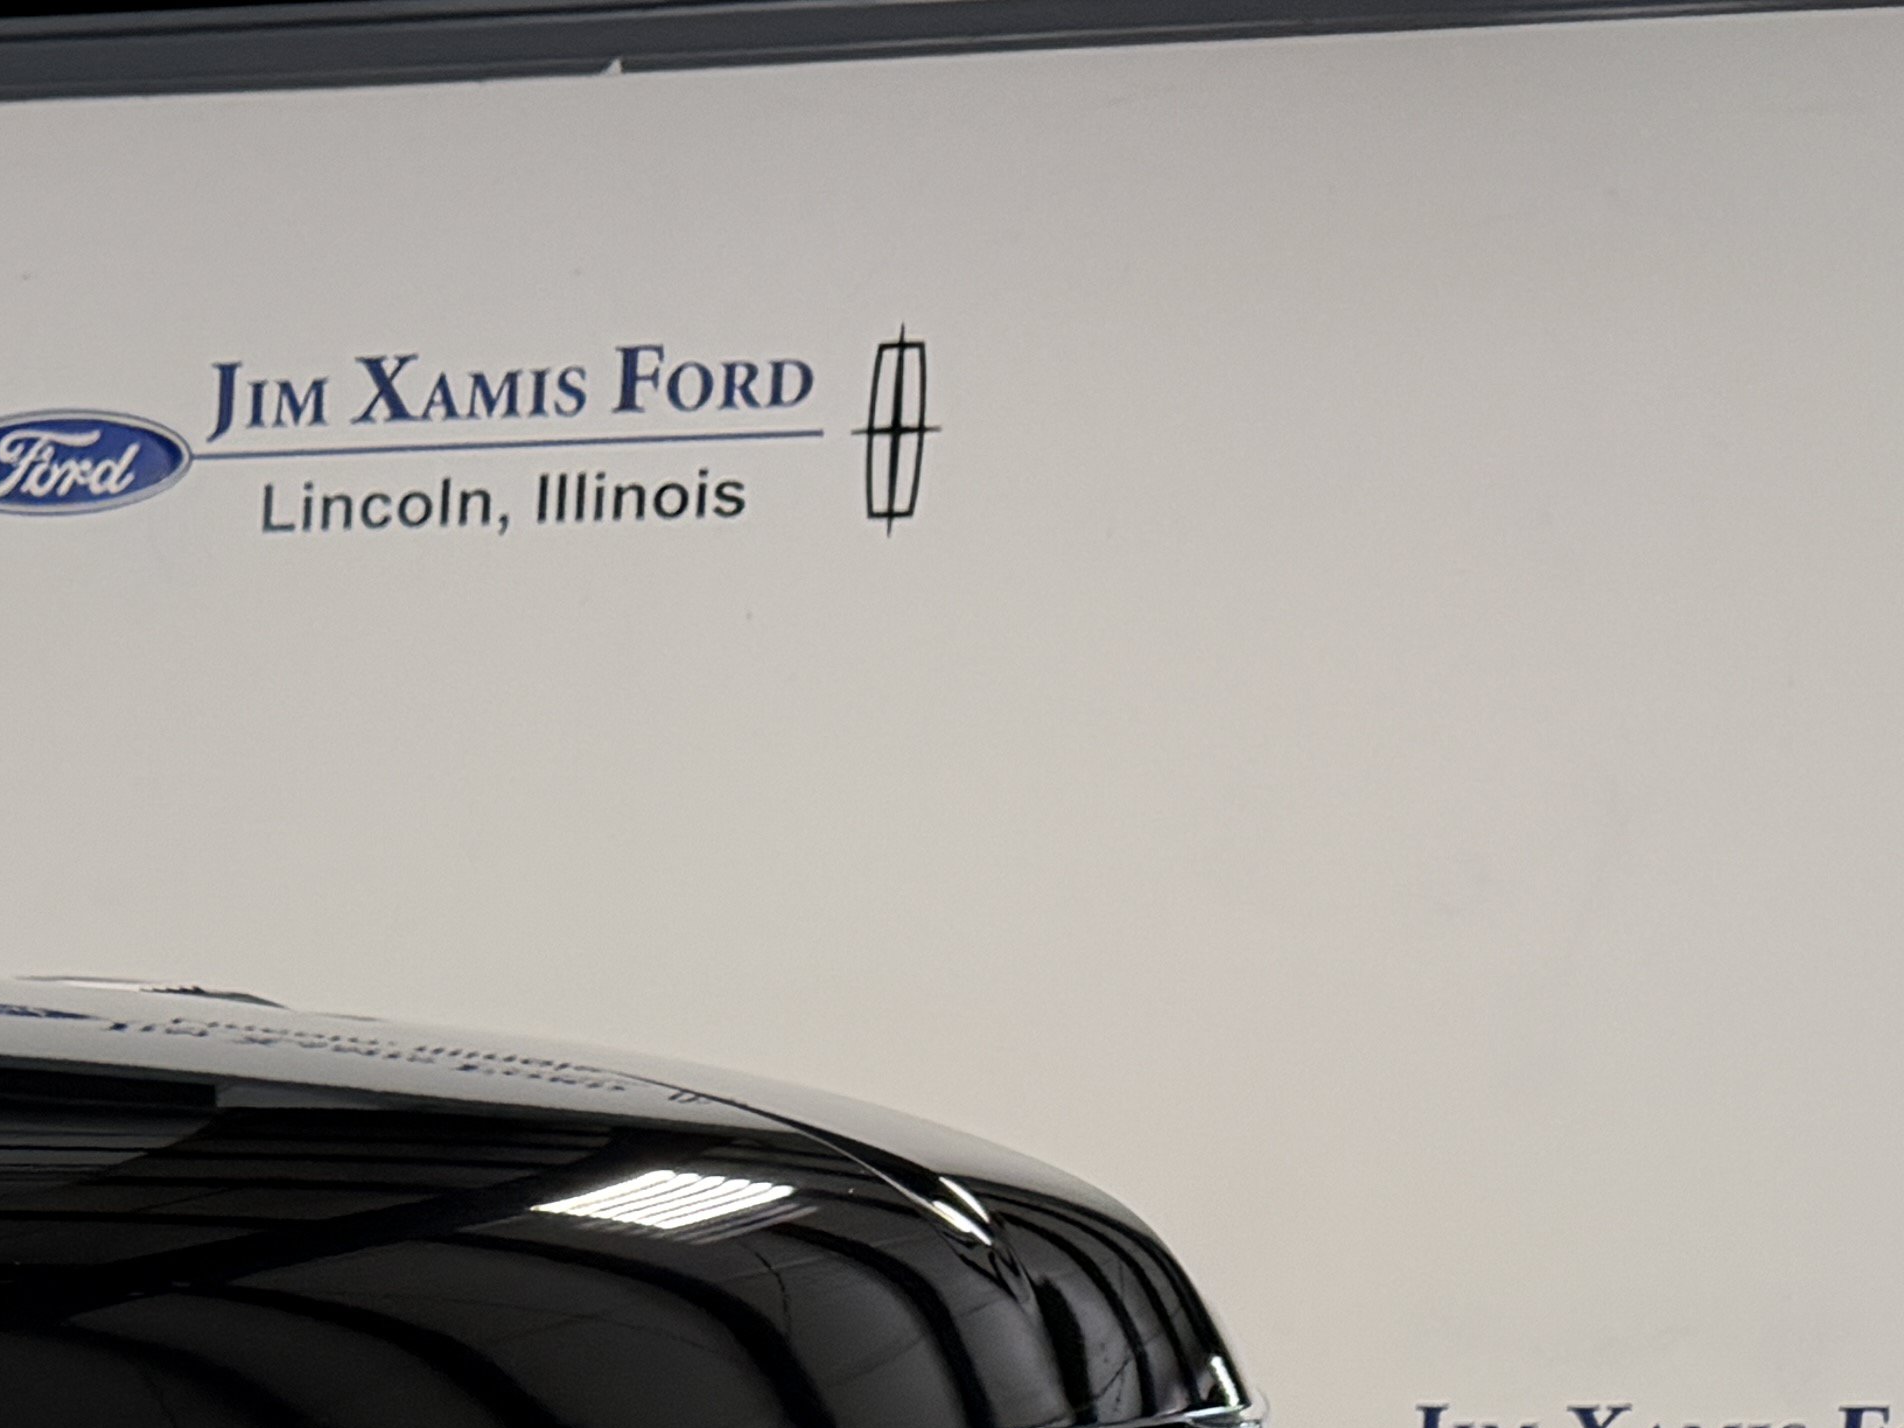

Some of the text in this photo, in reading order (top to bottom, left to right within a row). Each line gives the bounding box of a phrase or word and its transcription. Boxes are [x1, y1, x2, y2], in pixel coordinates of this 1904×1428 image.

[205, 344, 815, 443] JIM XAMIS FORD
[261, 467, 747, 536] Lincoln, Illinois
